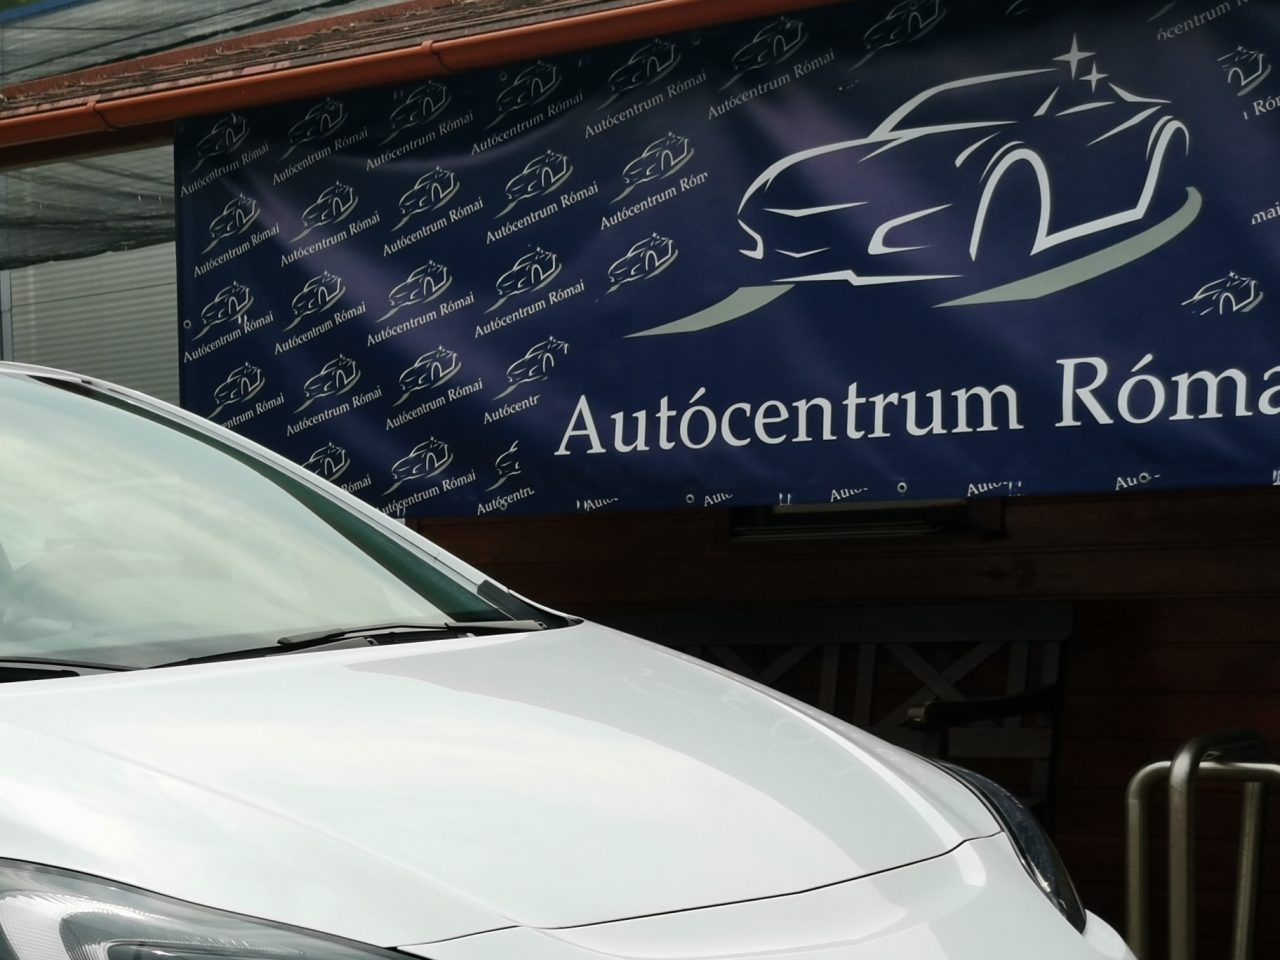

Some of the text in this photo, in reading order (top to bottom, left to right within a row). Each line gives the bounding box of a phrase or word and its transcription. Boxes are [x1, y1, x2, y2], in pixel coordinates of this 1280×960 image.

[584, 69, 707, 138] Autócentrum Római
[707, 48, 835, 120] Autócentrum Római
[366, 110, 474, 170] Autócentrum Római
[471, 89, 584, 155] Autócentrum Római
[180, 140, 269, 197] Autócentrum Római
[272, 127, 368, 185] Autócentrum Római
[383, 196, 484, 256] Autócentrum Római
[486, 181, 599, 244] Autócentrum Római
[600, 188, 677, 230] Autócentrum
[193, 222, 280, 277] Autócentrum Római
[280, 210, 380, 267] Autócentrum Római
[274, 302, 366, 354] Autócentrum Római
[367, 291, 475, 346] Autócentrum Római
[474, 279, 585, 337] Autócentrum Római
[183, 311, 274, 363] Autócentrum Római
[255, 392, 285, 415] Római
[286, 385, 382, 436] Autócentrum Római
[385, 378, 483, 430] Autócentrum Római
[554, 381, 1024, 455] Autócentrum
[442, 469, 476, 492] Római
